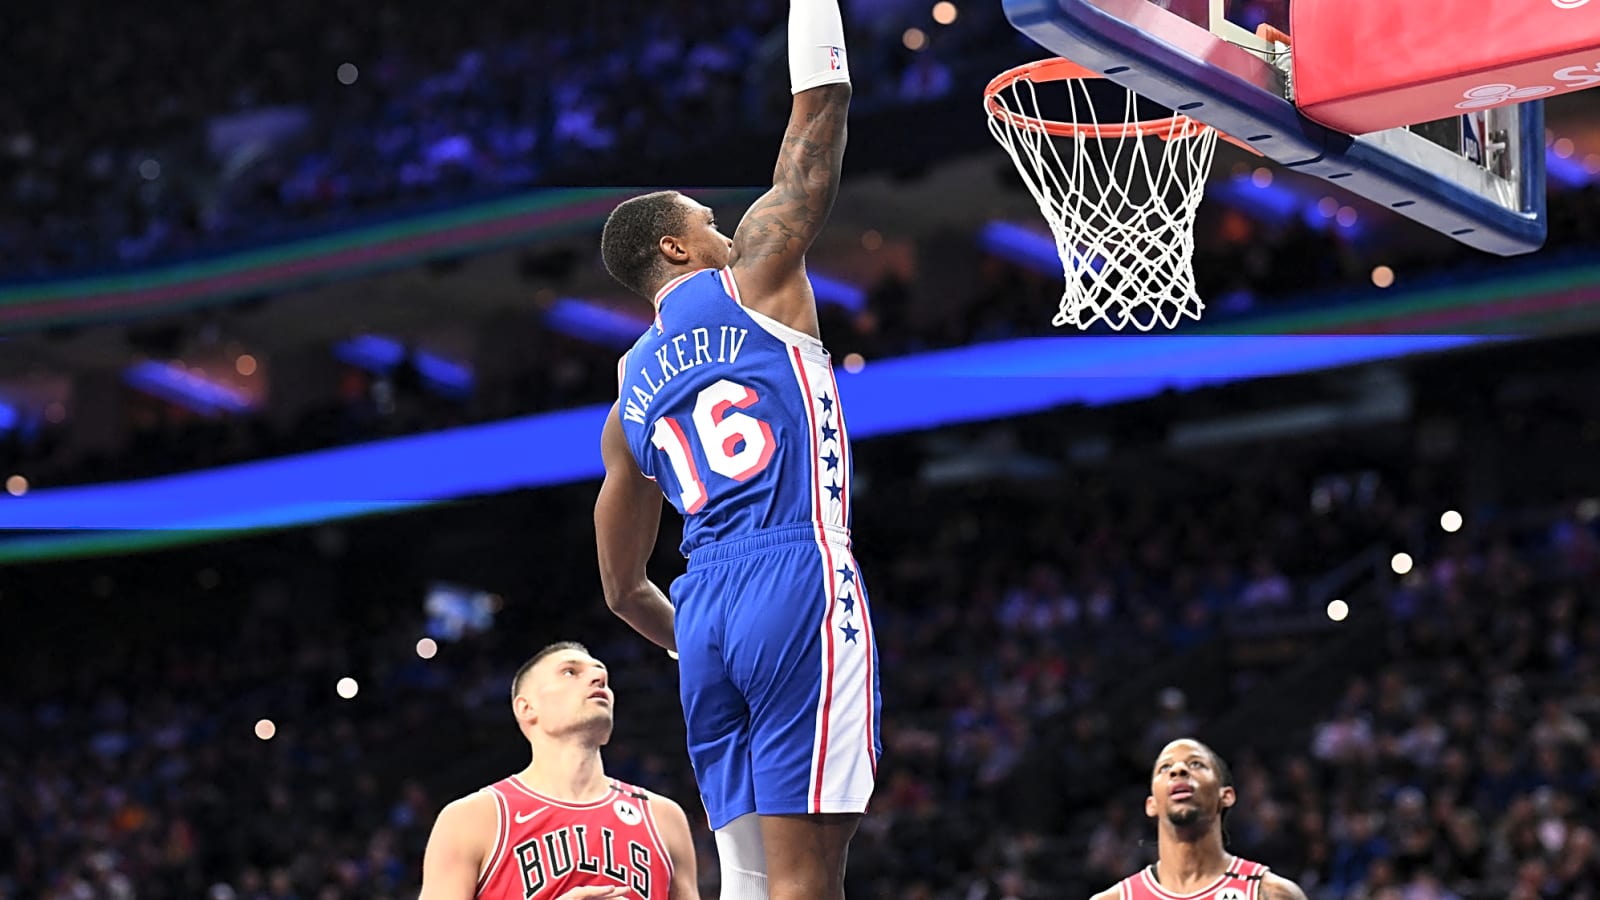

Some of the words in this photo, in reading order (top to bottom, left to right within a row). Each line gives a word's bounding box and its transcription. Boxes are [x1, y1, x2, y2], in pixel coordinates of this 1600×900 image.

[1553, 62, 1600, 87] S
[624, 327, 713, 425] WALKER
[718, 326, 748, 364] IV
[651, 379, 776, 515] 16
[514, 825, 652, 900] BULLS
